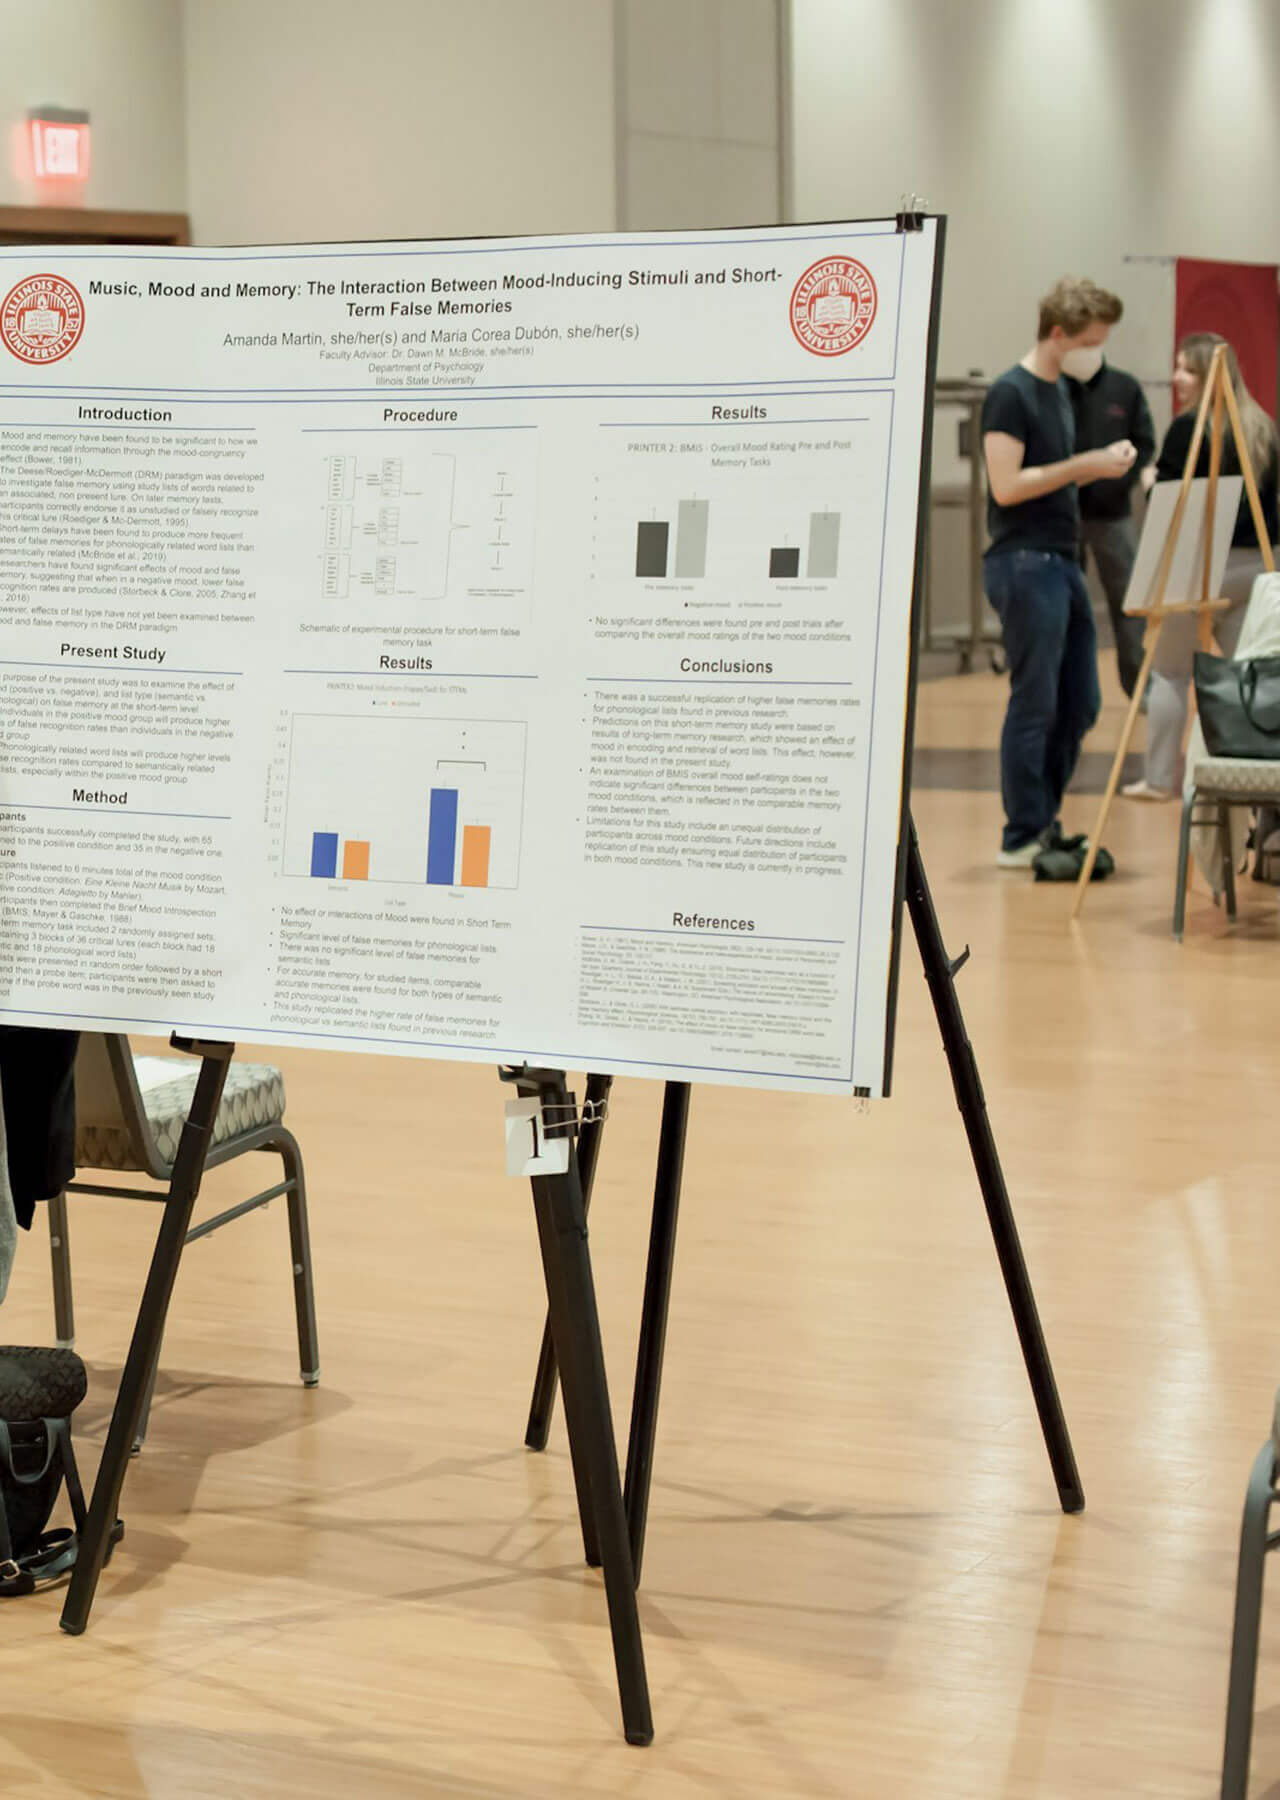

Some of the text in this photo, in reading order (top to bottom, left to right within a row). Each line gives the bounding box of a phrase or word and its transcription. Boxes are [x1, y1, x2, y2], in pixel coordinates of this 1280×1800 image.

[88, 268, 782, 298] Music, Mood and Memory: The Interaction Between Mood-Inducing Stimuli and Short-
[797, 263, 871, 305] ILLINOIS STATE
[7, 280, 78, 315] ILLINOIS STATE
[346, 300, 512, 315] Term False Memories
[223, 333, 277, 345] Amanda
[281, 332, 325, 347] Martin,
[330, 332, 397, 346] she/her(s)
[401, 331, 426, 343] and
[471, 328, 510, 340] Corea
[514, 326, 562, 341] Dubón,
[567, 325, 639, 340] she/her(s)
[799, 320, 864, 349] UNIVERSITY
[9, 331, 72, 358] UNIVERSITY
[368, 362, 484, 373] Department of Psychology
[375, 375, 475, 386] Illinois State University
[78, 407, 172, 421] Introduction
[383, 408, 458, 421] Procedure
[712, 405, 767, 418] Results
[628, 442, 667, 452] PRINTER
[710, 442, 741, 452] Overall
[742, 441, 768, 452] Mood
[769, 441, 796, 454] Rating
[798, 440, 812, 450] Pre
[814, 440, 831, 450] and
[832, 440, 852, 450] Post
[711, 457, 771, 469] Memory Tasks
[300, 624, 340, 633] Schematic
[341, 624, 350, 633] of
[351, 625, 402, 636] experimental
[403, 626, 443, 637] procedure
[444, 626, 456, 635] for
[500, 628, 520, 636] false
[383, 638, 432, 648] memory task
[60, 644, 166, 663] Present Study
[380, 656, 432, 669] Results
[680, 658, 773, 672] Conclusions
[72, 790, 128, 804] Method
[673, 913, 755, 930] References
[528, 1115, 542, 1158] 1
